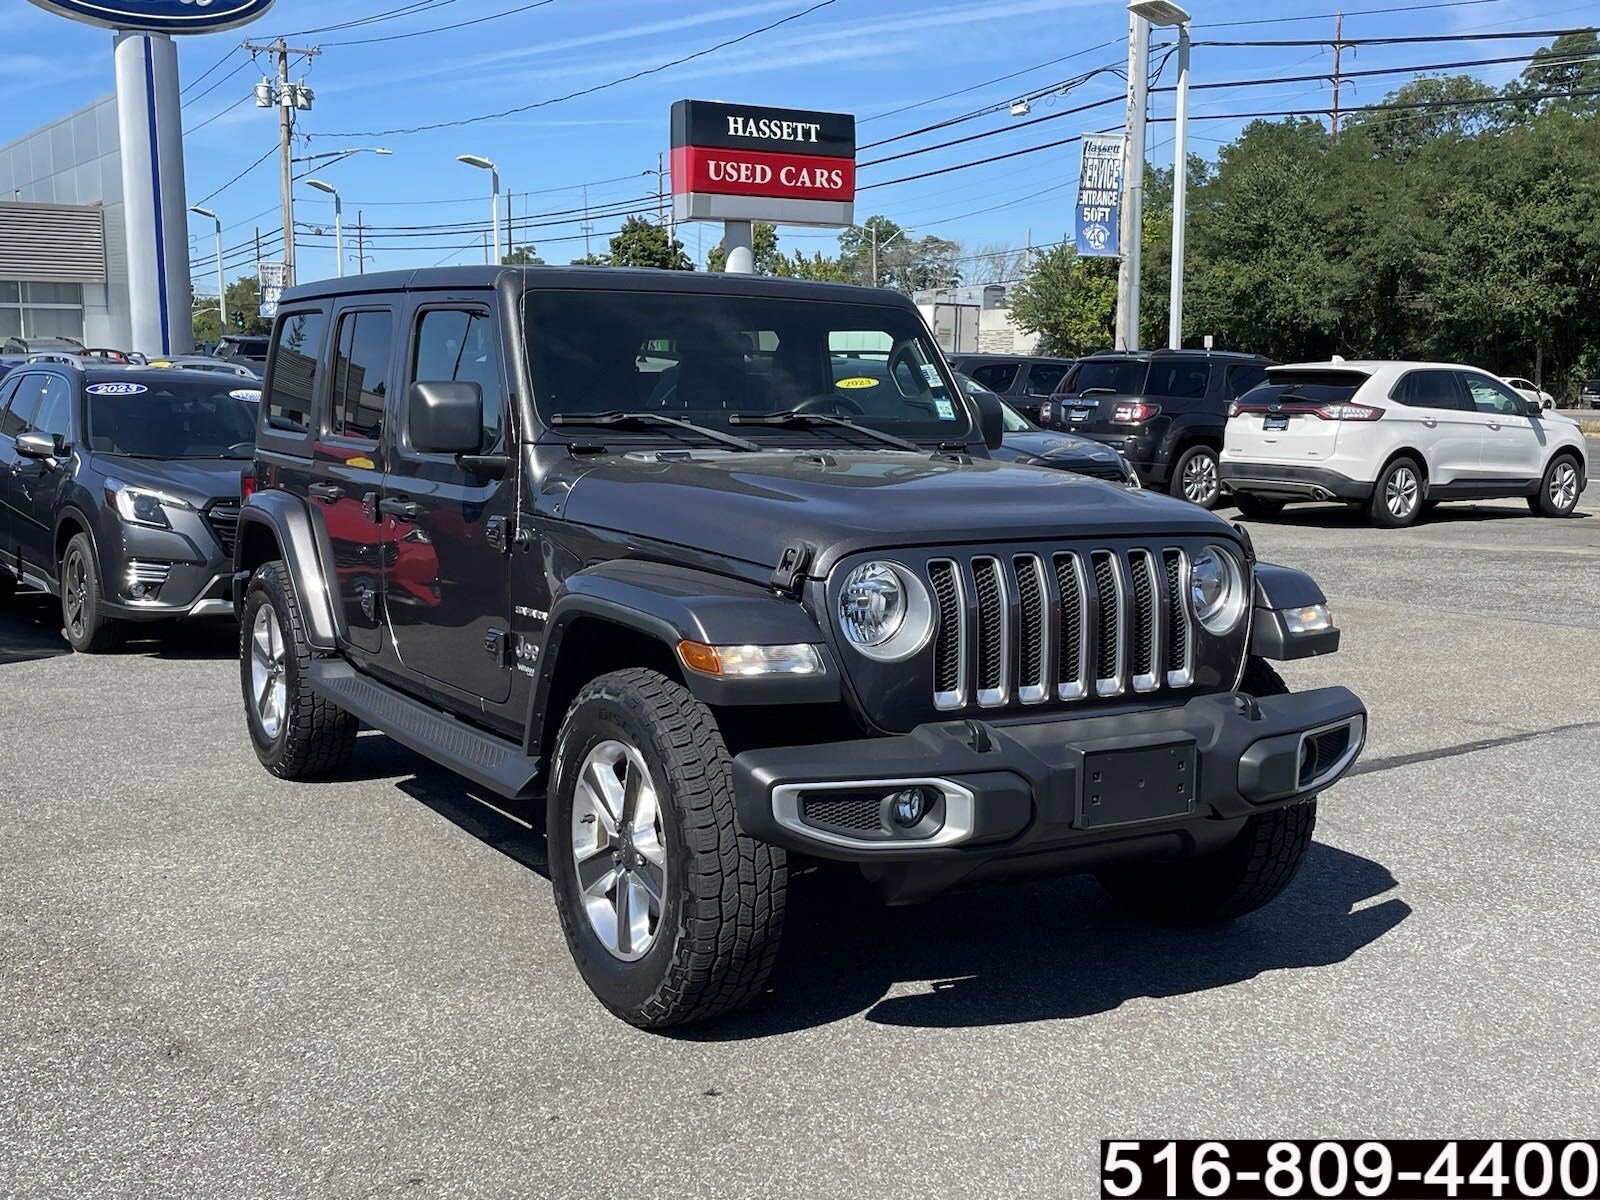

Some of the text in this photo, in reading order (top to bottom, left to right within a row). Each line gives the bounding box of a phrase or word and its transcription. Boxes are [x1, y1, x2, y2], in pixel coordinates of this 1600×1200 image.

[727, 116, 820, 142] HASSETT
[707, 160, 843, 189] USED CARS
[1081, 157, 1120, 189] SERVICE
[1083, 207, 1111, 223] 50FT
[97, 383, 139, 394] 2023
[845, 379, 872, 388] 2023
